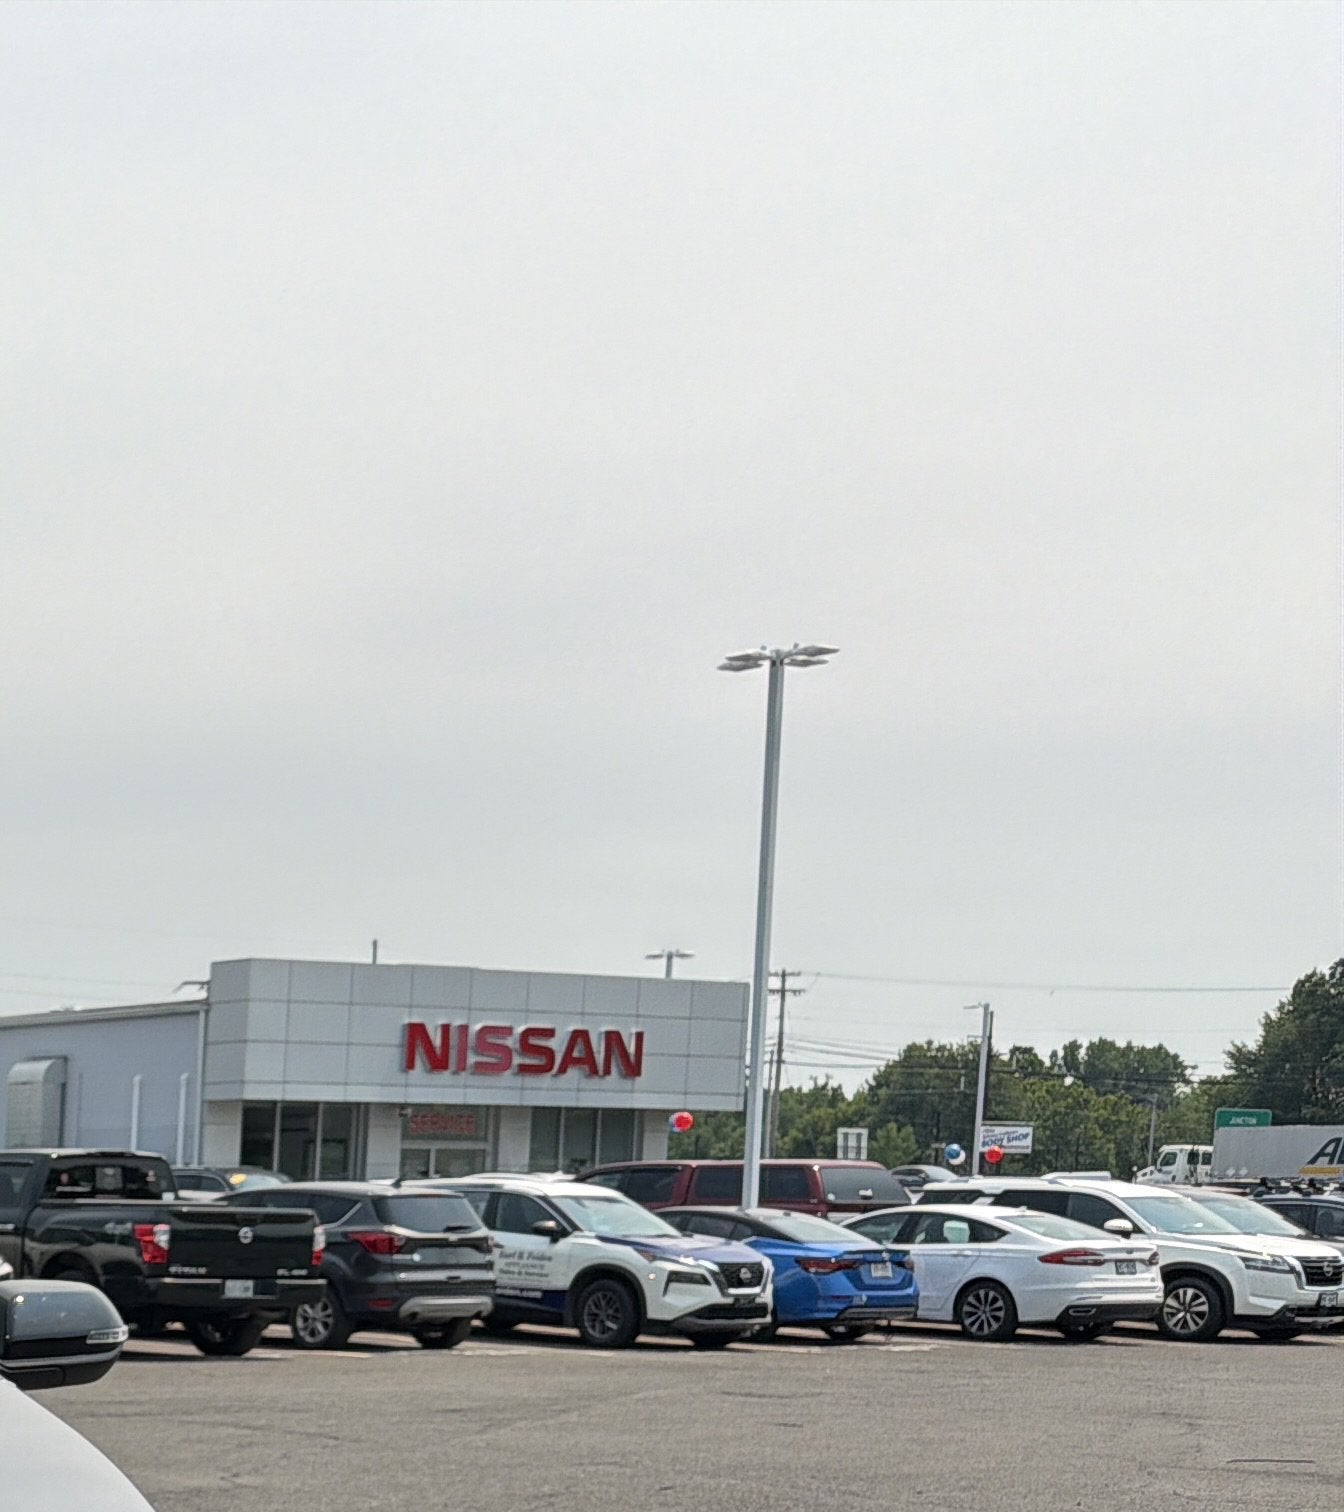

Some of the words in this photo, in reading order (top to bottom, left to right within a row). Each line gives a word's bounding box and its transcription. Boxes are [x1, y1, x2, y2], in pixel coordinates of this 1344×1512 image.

[404, 1021, 645, 1078] NISSAN
[410, 1112, 477, 1134] SERVICE
[1307, 1136, 1344, 1166] A
